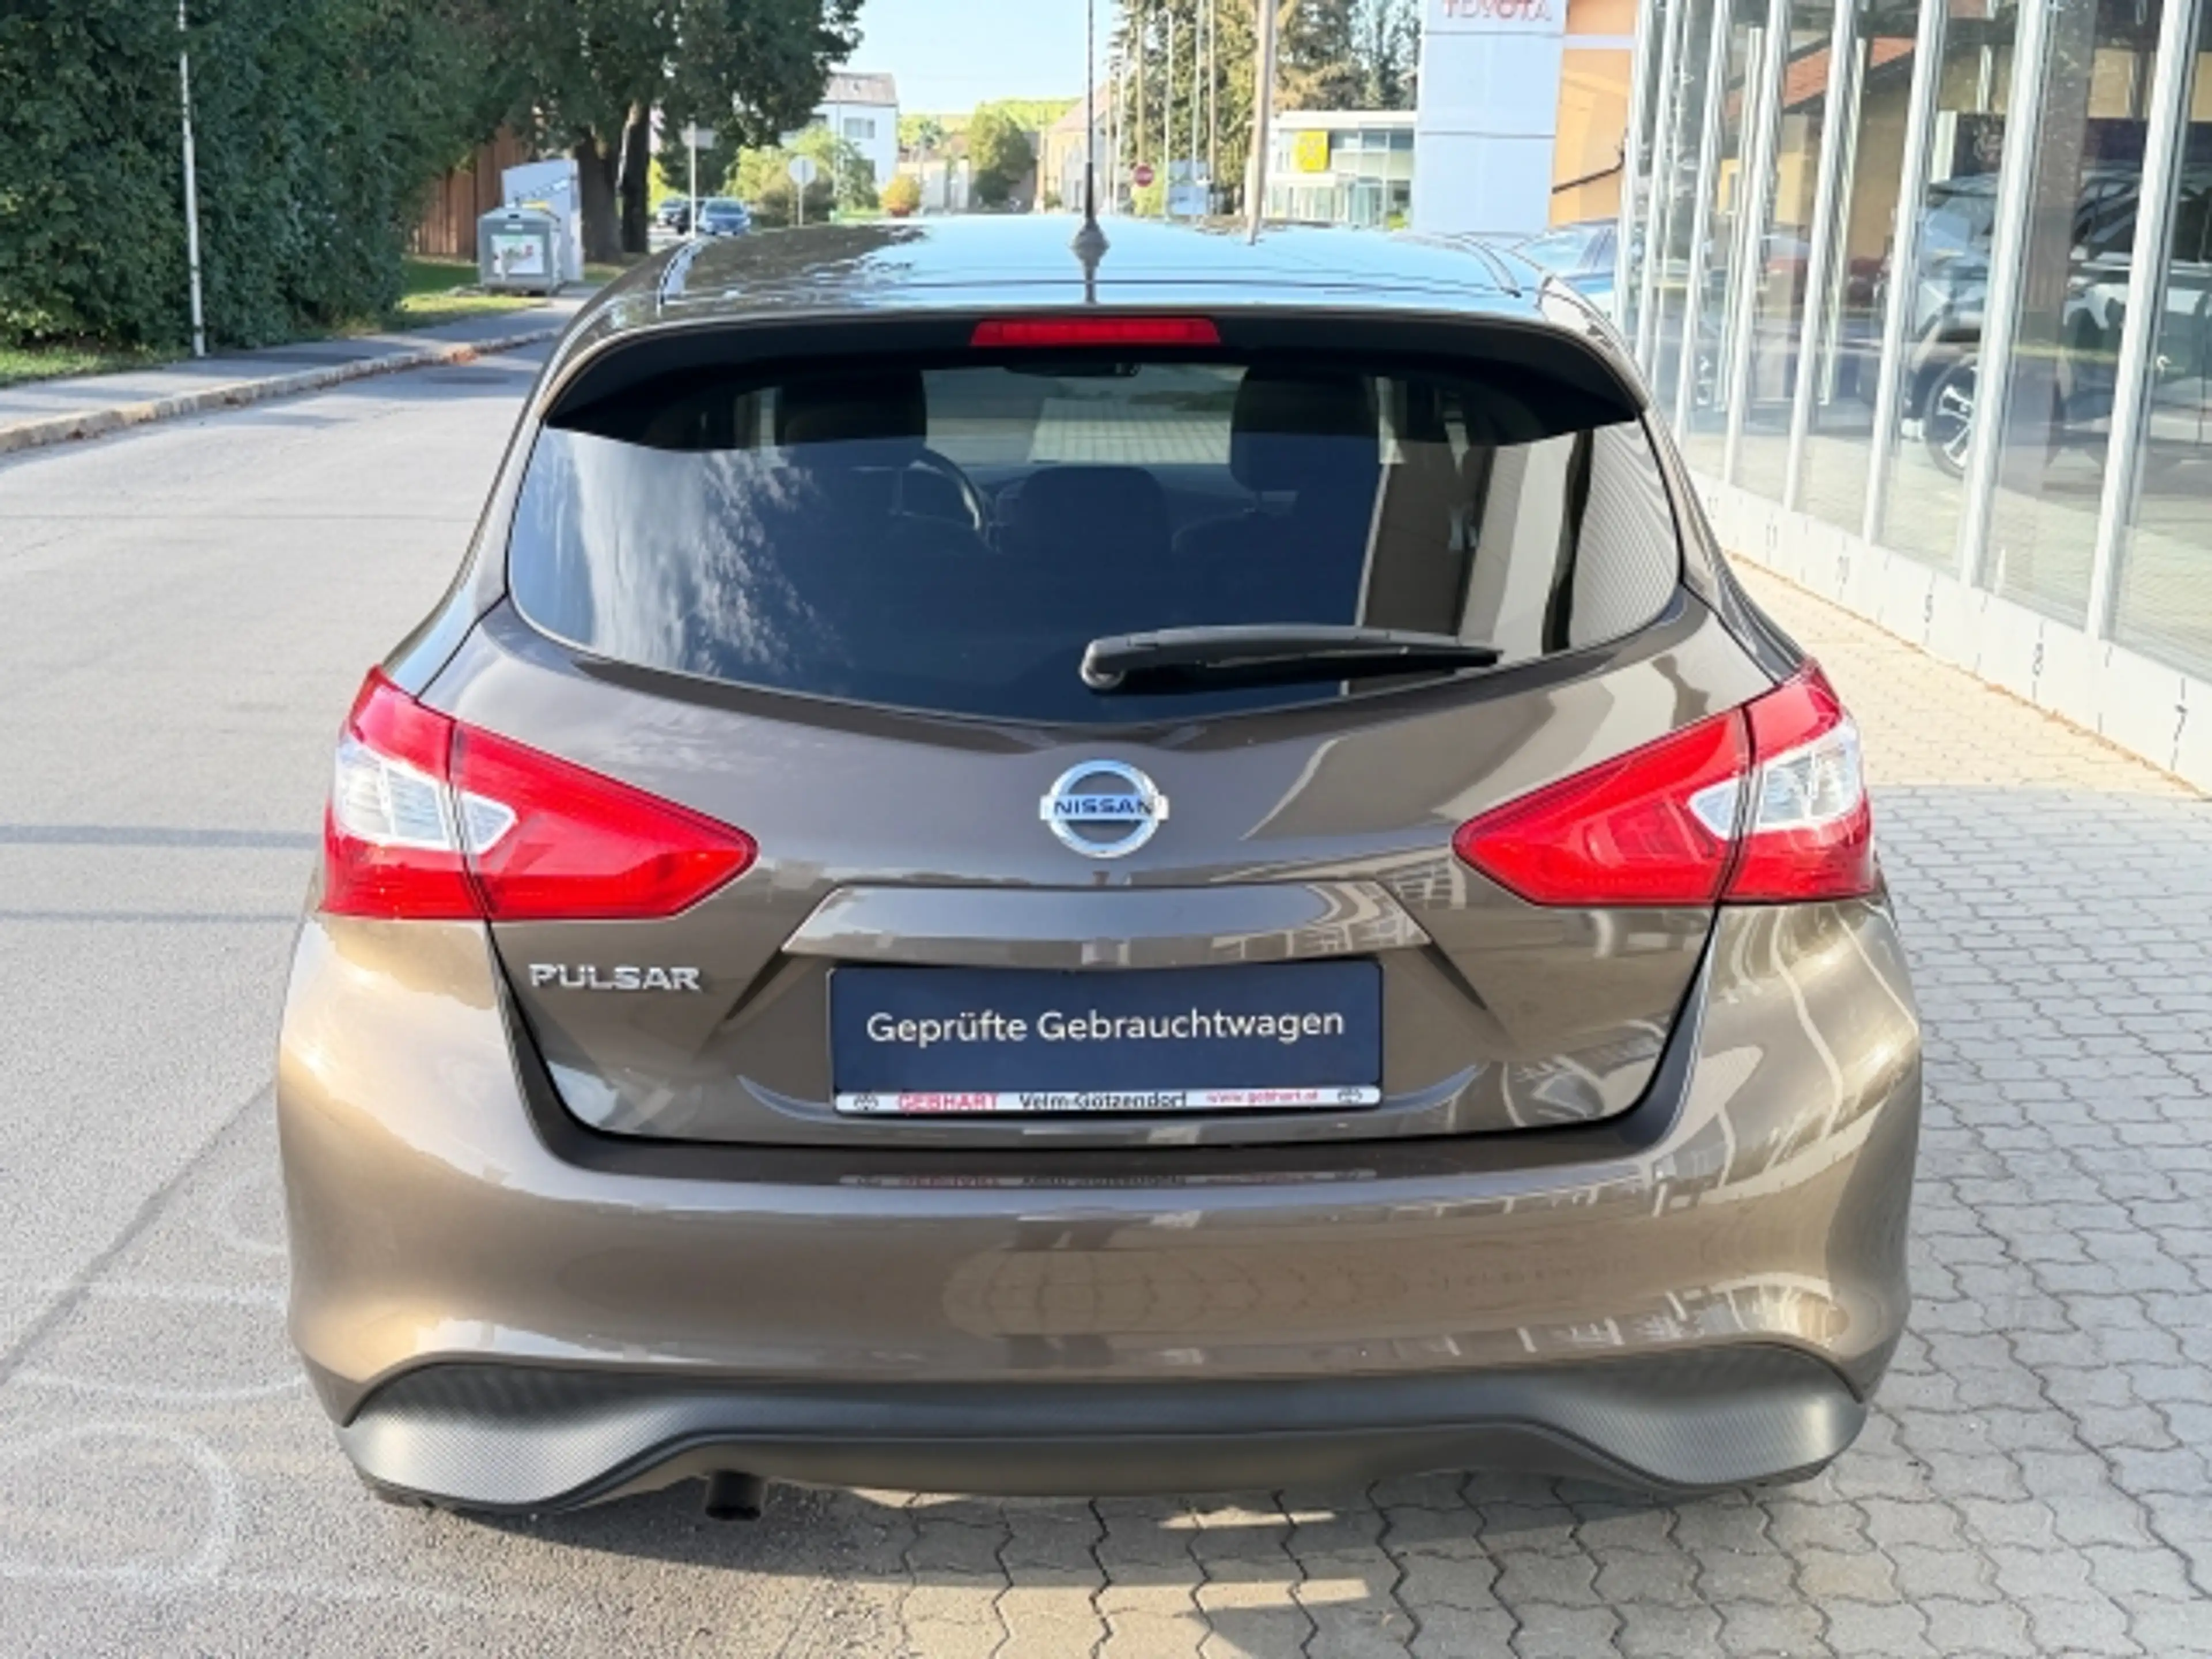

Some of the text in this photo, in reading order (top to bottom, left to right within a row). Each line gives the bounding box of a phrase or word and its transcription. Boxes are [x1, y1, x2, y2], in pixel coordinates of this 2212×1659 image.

[1445, 0, 1554, 21] TOYOTA
[1054, 798, 1152, 815] NISSAN
[528, 963, 702, 991] PULSAR
[866, 1007, 1345, 1048] Geprüfte Gebrauchtwagen
[897, 1093, 998, 1112] GEBHART
